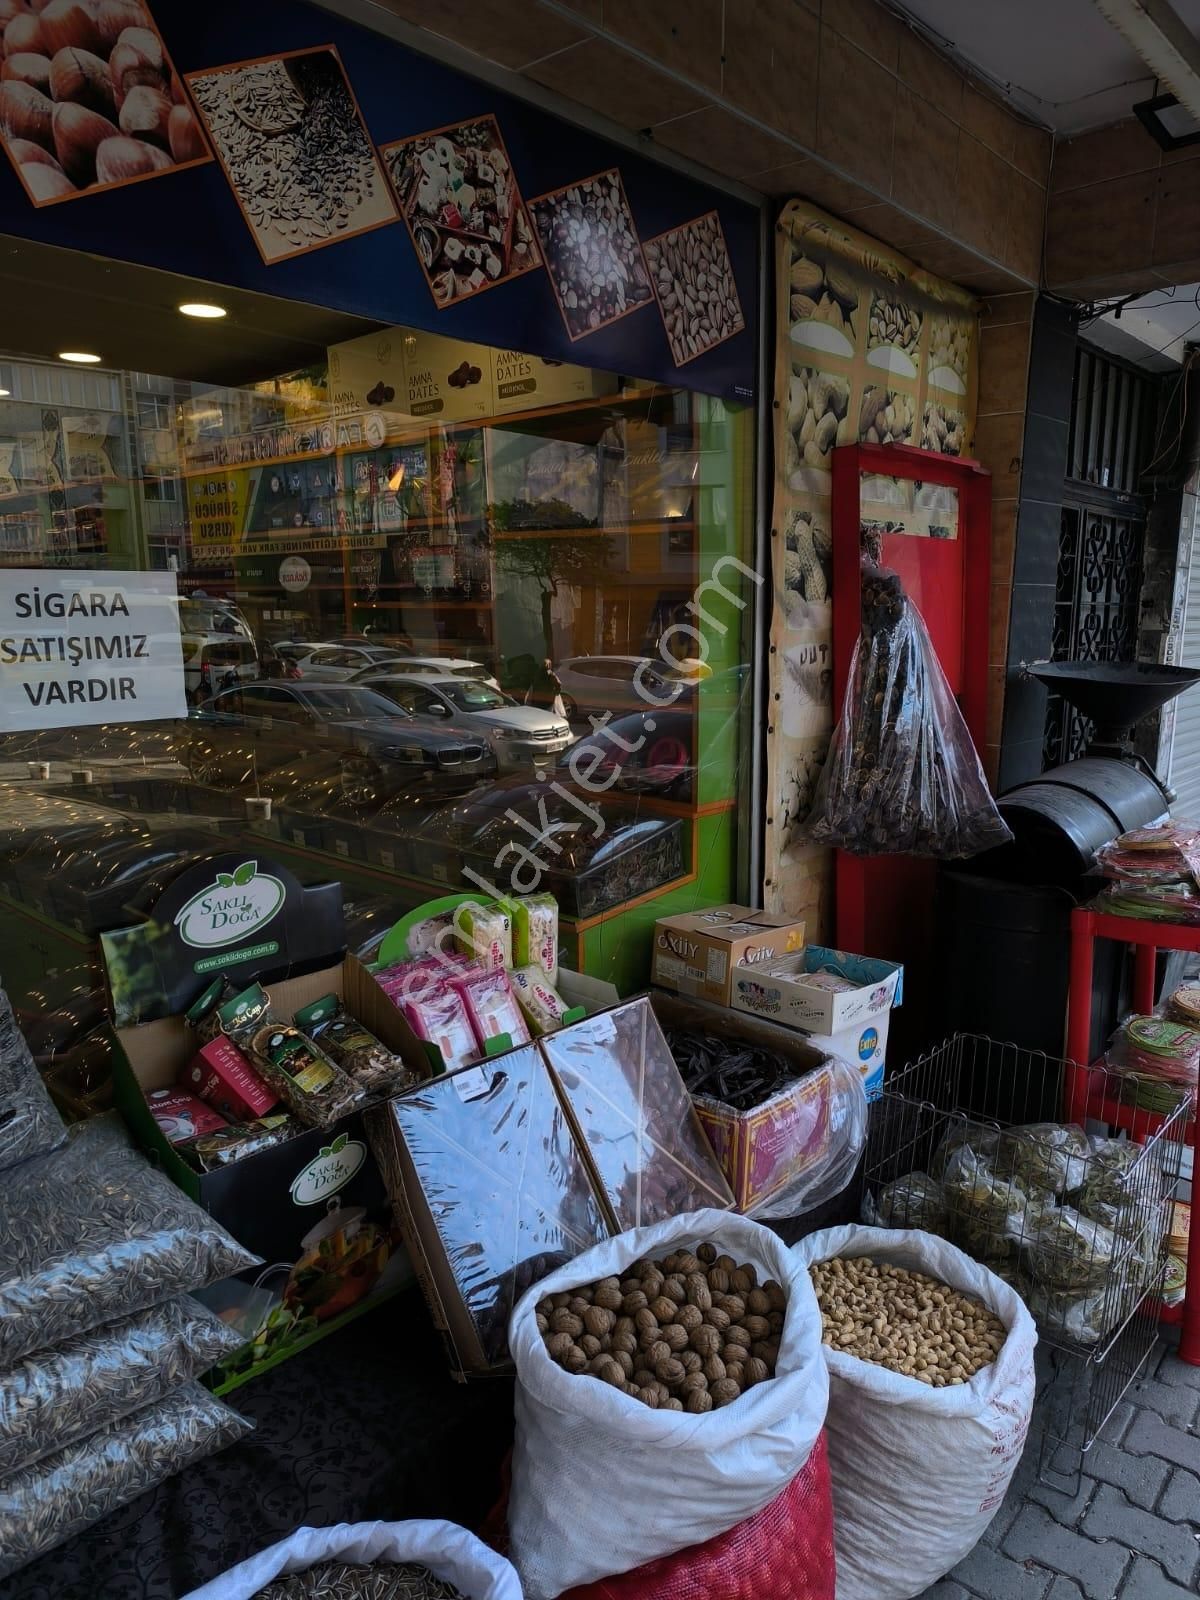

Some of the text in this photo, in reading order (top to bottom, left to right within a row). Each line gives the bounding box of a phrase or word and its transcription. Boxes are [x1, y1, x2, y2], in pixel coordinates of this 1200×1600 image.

[408, 372, 432, 387] AMNA
[497, 361, 531, 380] DATES
[334, 391, 354, 404] AMNA
[409, 384, 439, 401] DATES
[15, 587, 130, 618] SİGARA
[0, 635, 149, 666] SATIŞIMIZ
[23, 677, 137, 707] VARDIR
[200, 896, 247, 915] SAKLI
